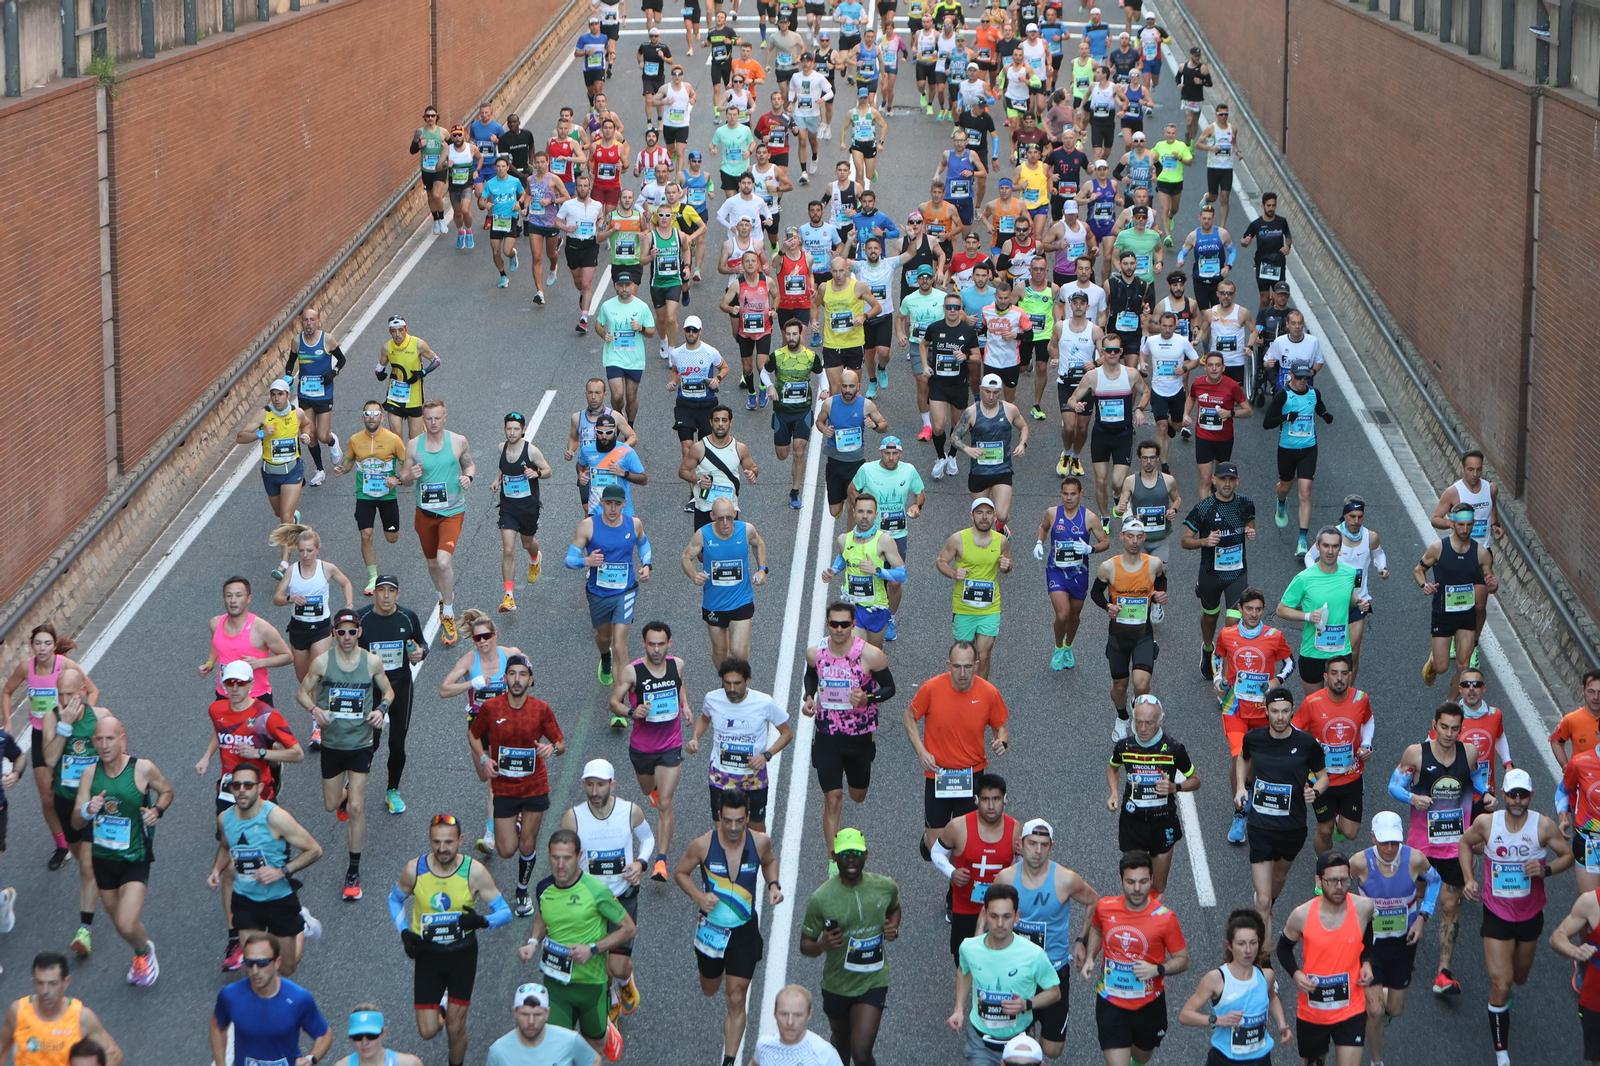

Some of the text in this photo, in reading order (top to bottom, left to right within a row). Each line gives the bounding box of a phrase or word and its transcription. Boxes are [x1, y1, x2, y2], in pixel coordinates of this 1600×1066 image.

[991, 322, 1009, 330] TRAIL
[823, 665, 852, 677] PUTOS
[652, 680, 676, 689] BARCO
[656, 691, 674, 699] ZURICH
[218, 732, 255, 746] YORK
[1266, 786, 1287, 794] ZURICH
[601, 850, 622, 858] ZURICH
[1033, 892, 1051, 907] N
[1375, 899, 1403, 907] NEWBURY
[435, 914, 457, 922] ZURICH
[1019, 922, 1041, 931] ZURICH
[864, 938, 881, 947] ZURICH
[1321, 976, 1344, 984] ZURICH
[1113, 982, 1135, 990] ROBERTO
[988, 993, 1013, 1001] ZURICH
[1247, 1015, 1266, 1024] ZURICH
